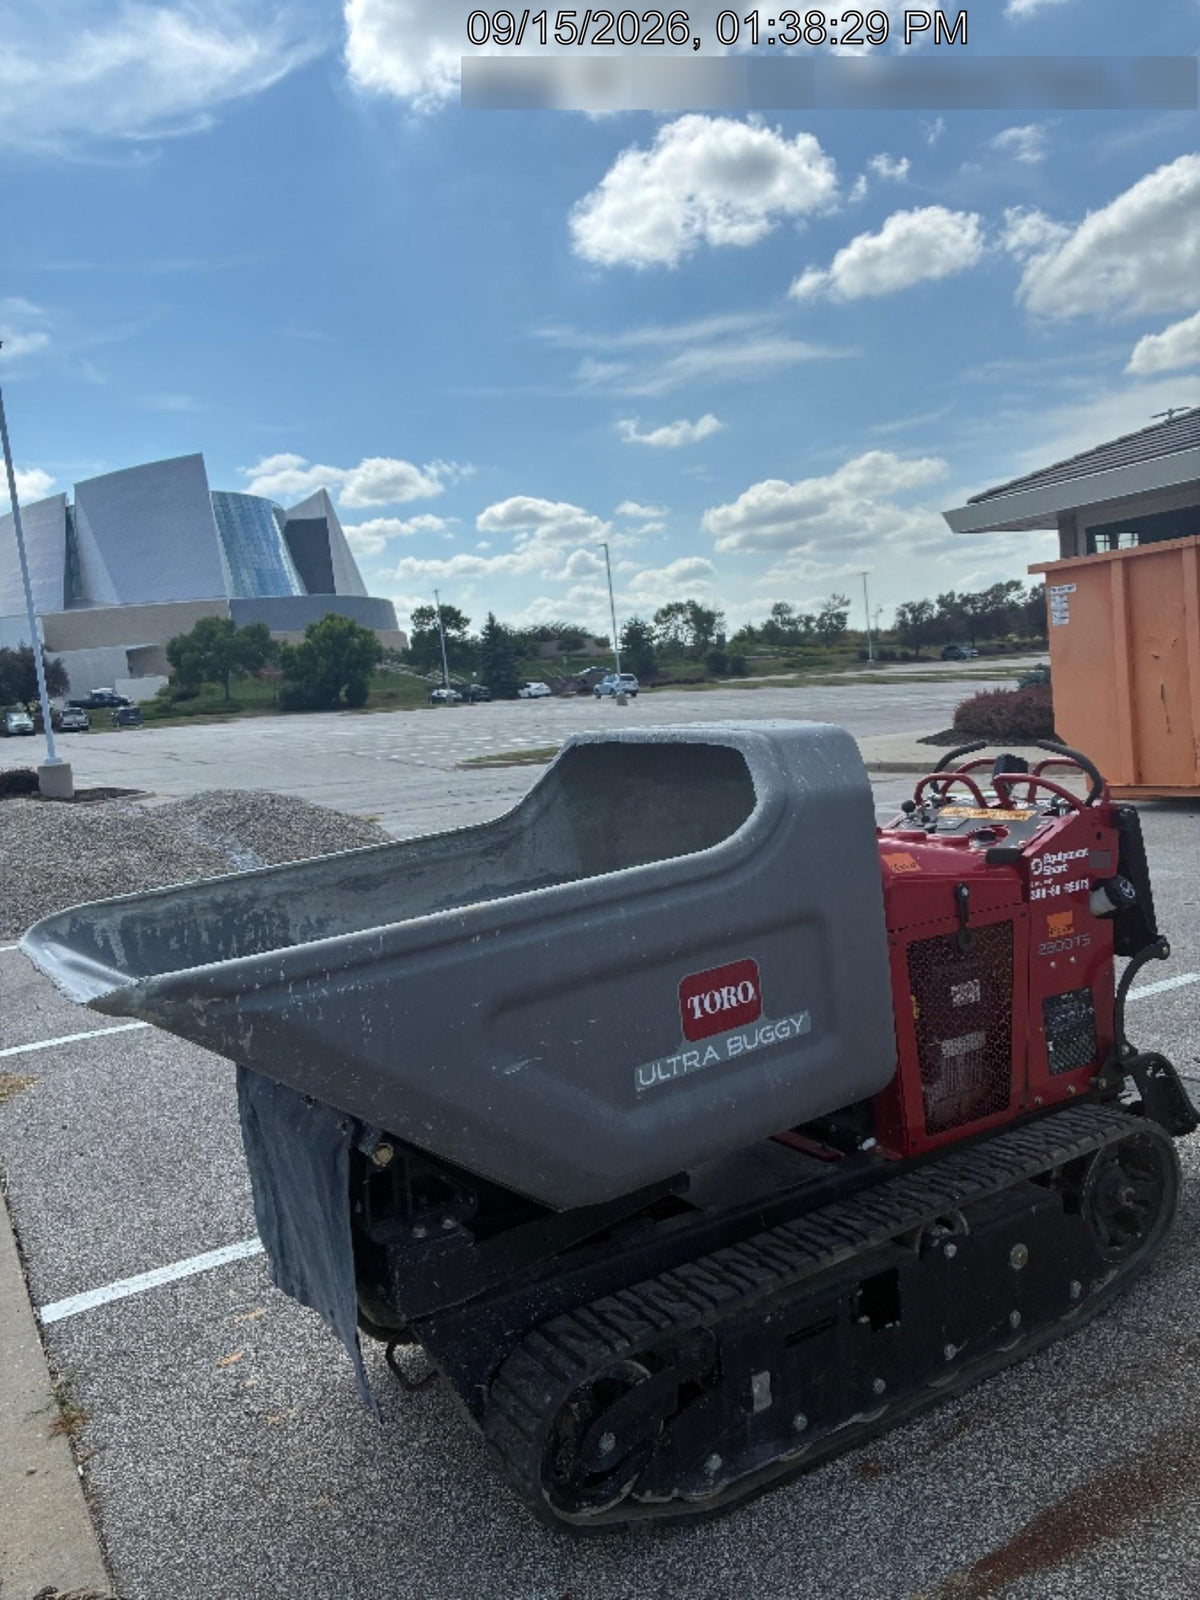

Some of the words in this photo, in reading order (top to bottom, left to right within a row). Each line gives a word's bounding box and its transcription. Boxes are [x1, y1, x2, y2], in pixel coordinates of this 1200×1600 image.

[687, 980, 756, 1020] TORO
[637, 1045, 720, 1086] ULTRA
[726, 1014, 806, 1057] BUGGY
